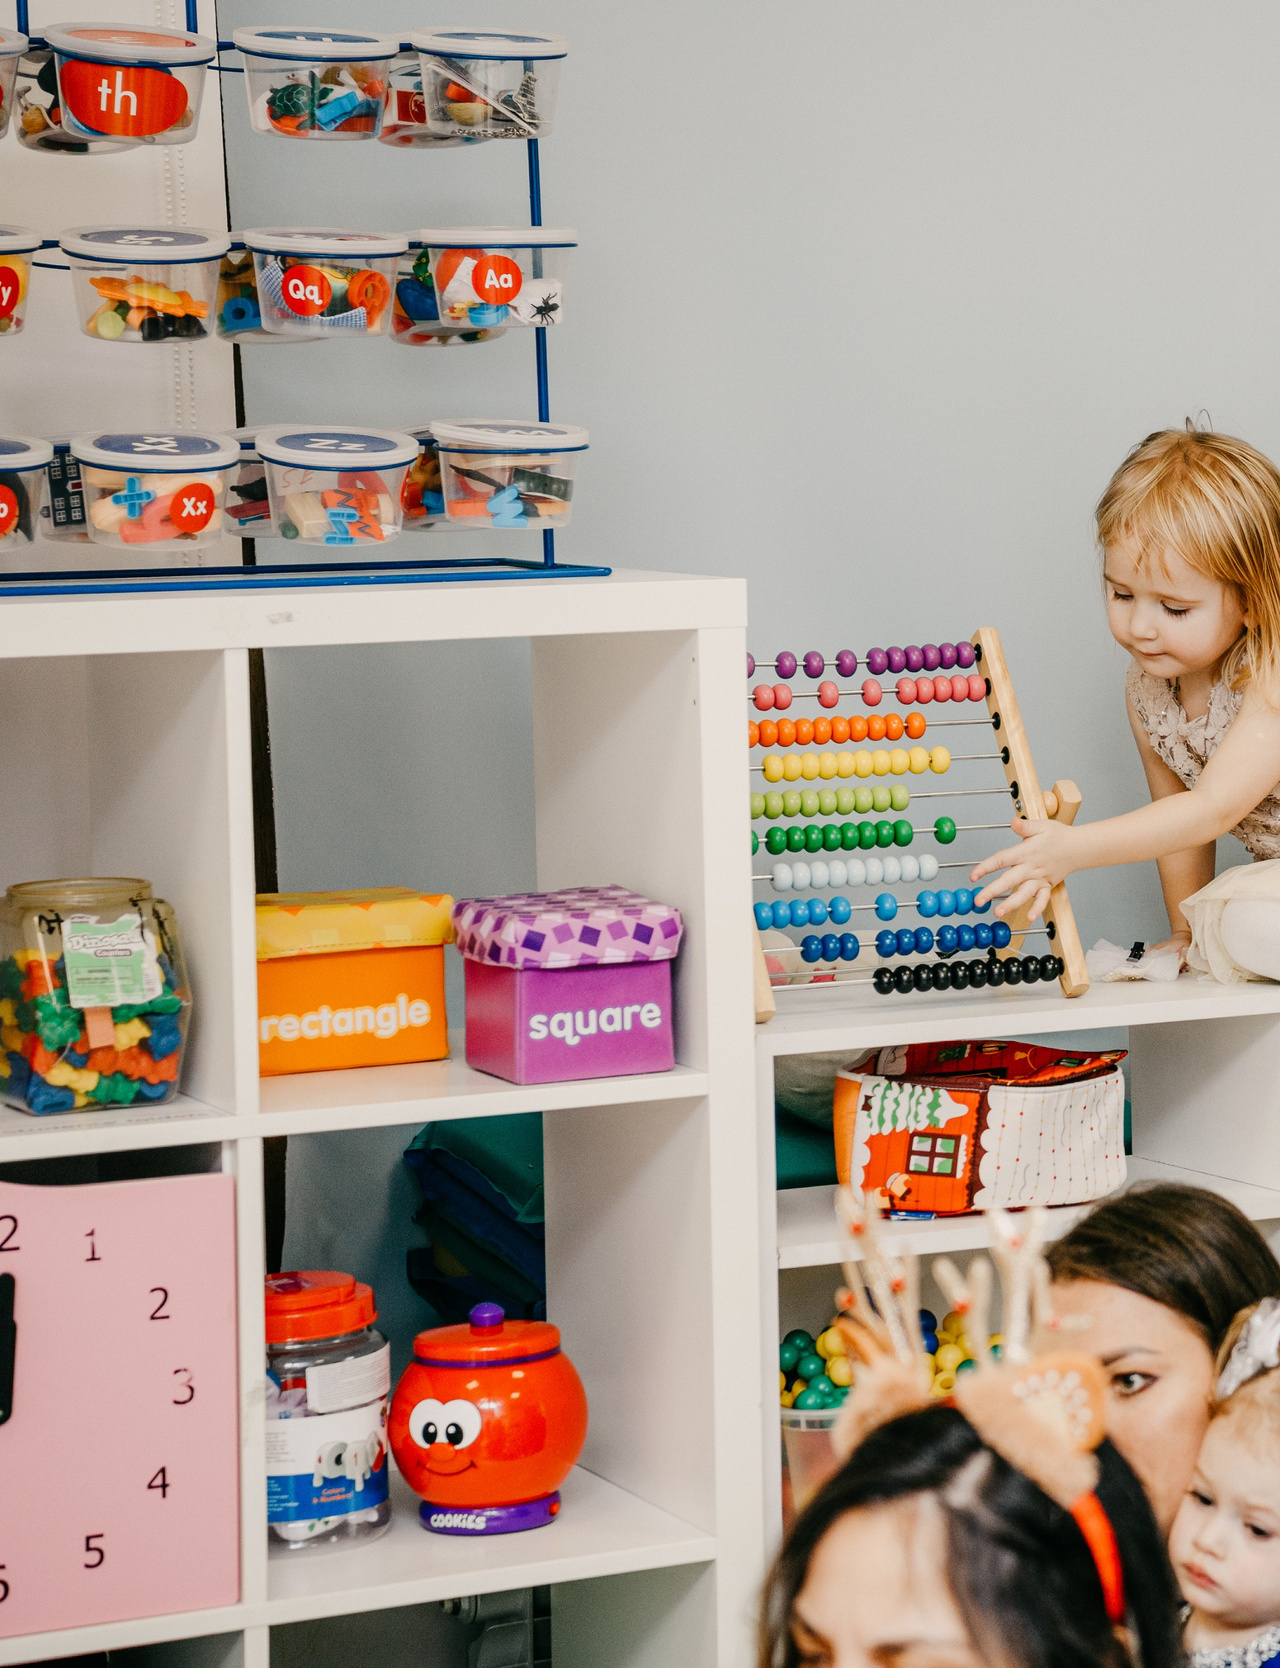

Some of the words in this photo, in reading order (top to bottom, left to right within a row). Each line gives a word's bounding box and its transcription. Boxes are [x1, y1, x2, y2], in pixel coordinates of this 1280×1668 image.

[97, 70, 138, 116] th
[0, 280, 12, 306] y
[288, 278, 323, 304] Qq
[484, 268, 513, 289] Aa
[305, 438, 367, 451] Zz
[181, 497, 207, 517] Xx
[260, 993, 430, 1042] rectangle
[529, 1002, 662, 1046] square
[0, 1215, 20, 1252] 2
[84, 1228, 101, 1262] 1
[149, 1287, 170, 1320] 2
[172, 1368, 195, 1405] 3
[147, 1466, 170, 1499] 4
[83, 1533, 106, 1569] 5
